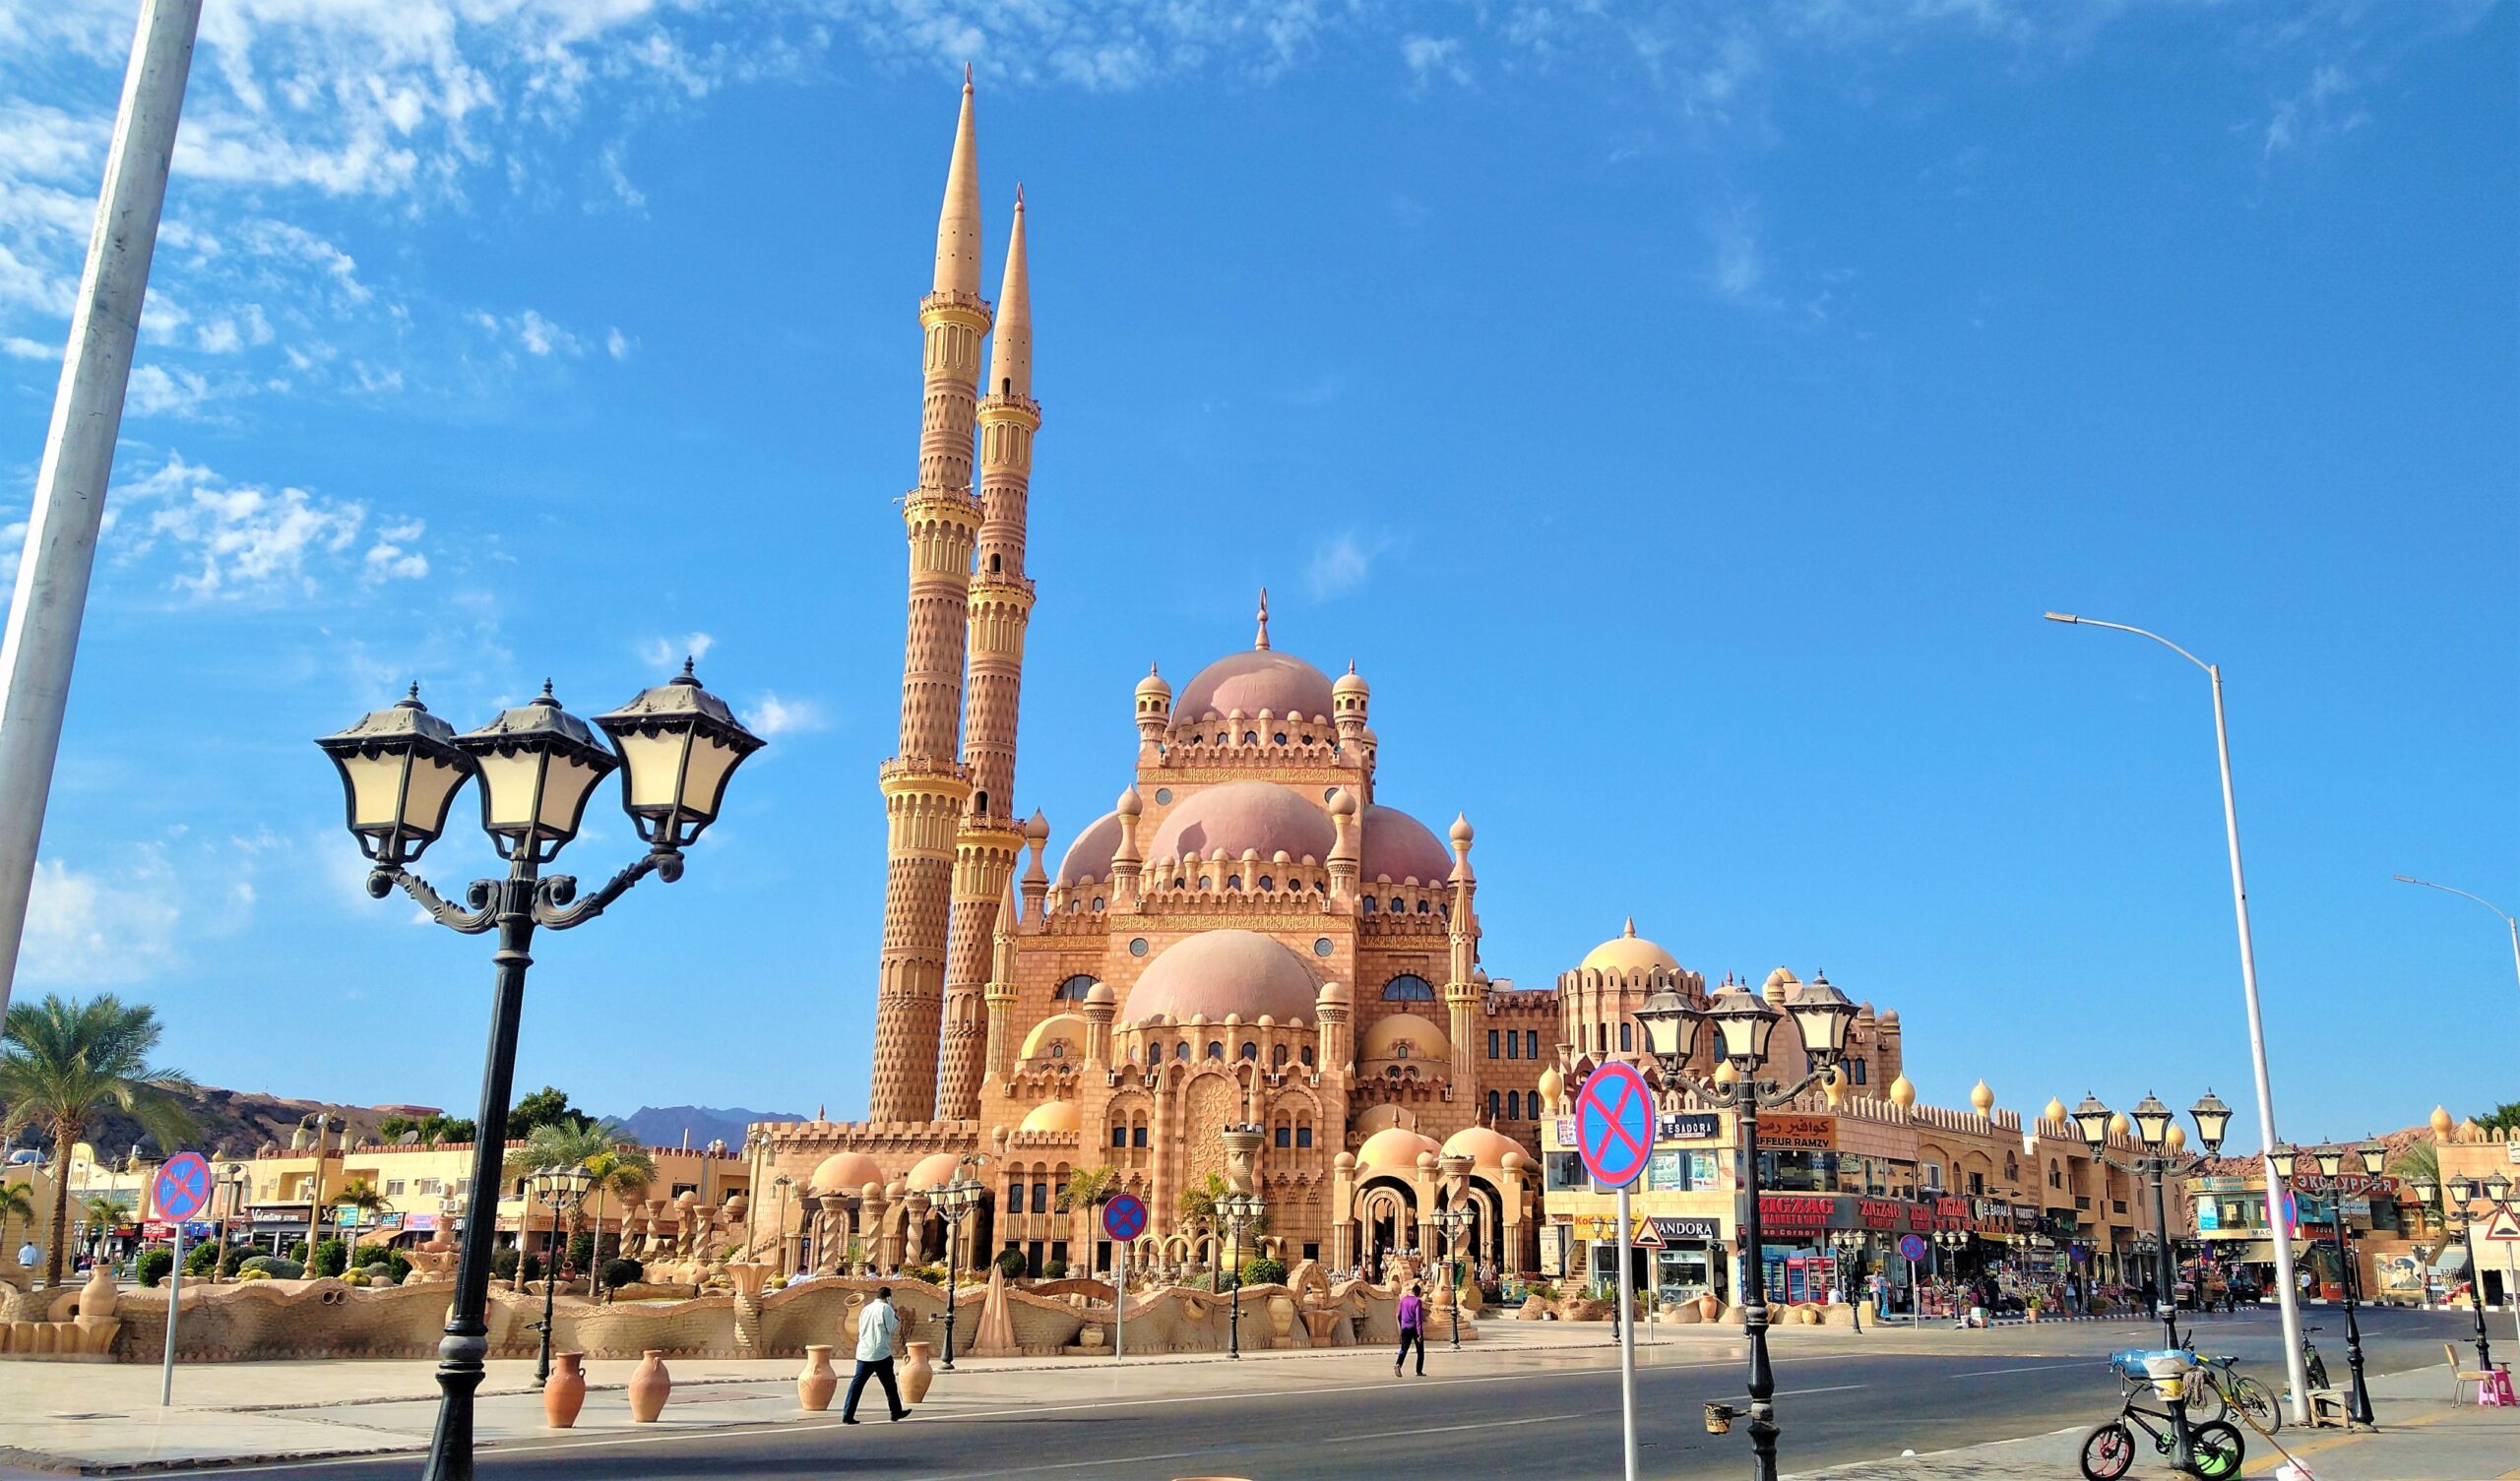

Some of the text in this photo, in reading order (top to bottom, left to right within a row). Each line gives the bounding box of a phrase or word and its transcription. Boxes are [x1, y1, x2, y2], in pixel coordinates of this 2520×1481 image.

[1668, 1123, 1712, 1134] ESADORA
[1785, 1119, 1829, 1137] كوافير
[1795, 1138, 1829, 1148] RAMZY
[1759, 1197, 1835, 1214] ZIGZAG
[1859, 1201, 1902, 1218] ZIGZAG
[251, 1208, 282, 1221] Valentino
